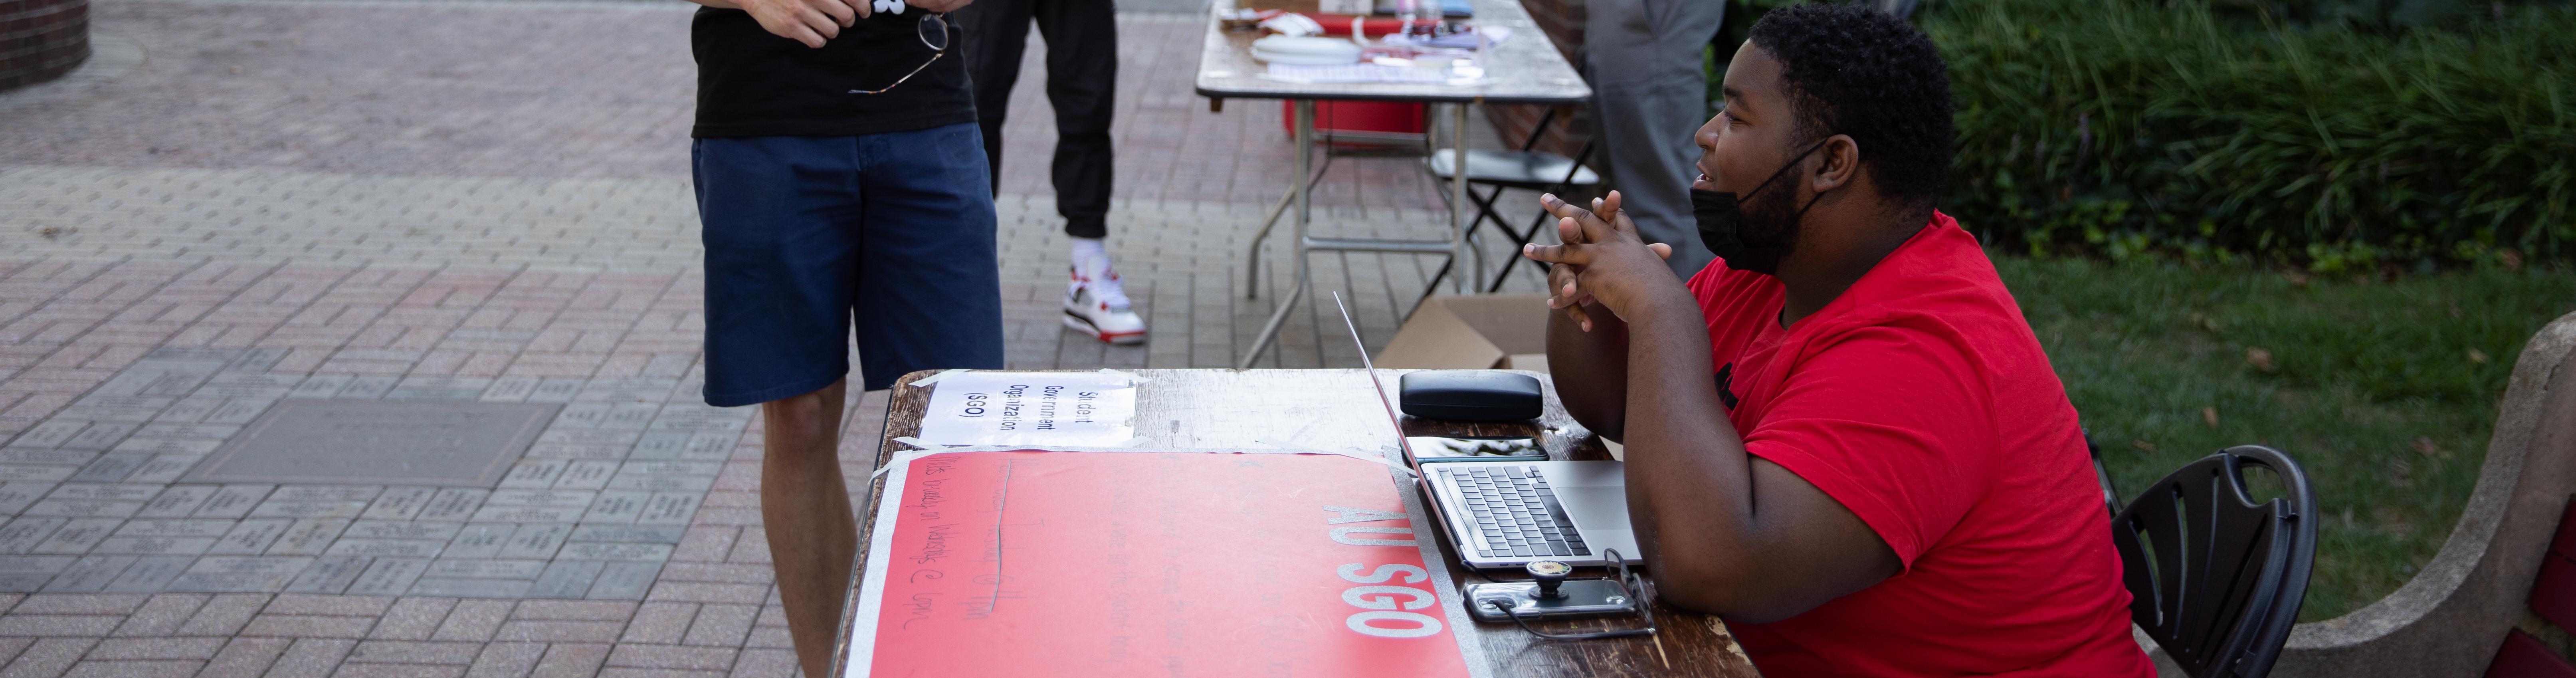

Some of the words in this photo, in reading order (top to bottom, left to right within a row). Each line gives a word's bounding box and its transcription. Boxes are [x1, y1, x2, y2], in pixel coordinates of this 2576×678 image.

[959, 393, 988, 417] (SGO)
[1000, 385, 1030, 430] Organization
[1036, 385, 1064, 430] Government
[1075, 392, 1098, 423] Student
[926, 456, 961, 475] Meets
[921, 512, 940, 521] on
[1323, 505, 1419, 549] AU
[1111, 571, 1137, 587] the
[1337, 563, 1443, 638] SGO
[1087, 636, 1139, 664] body
